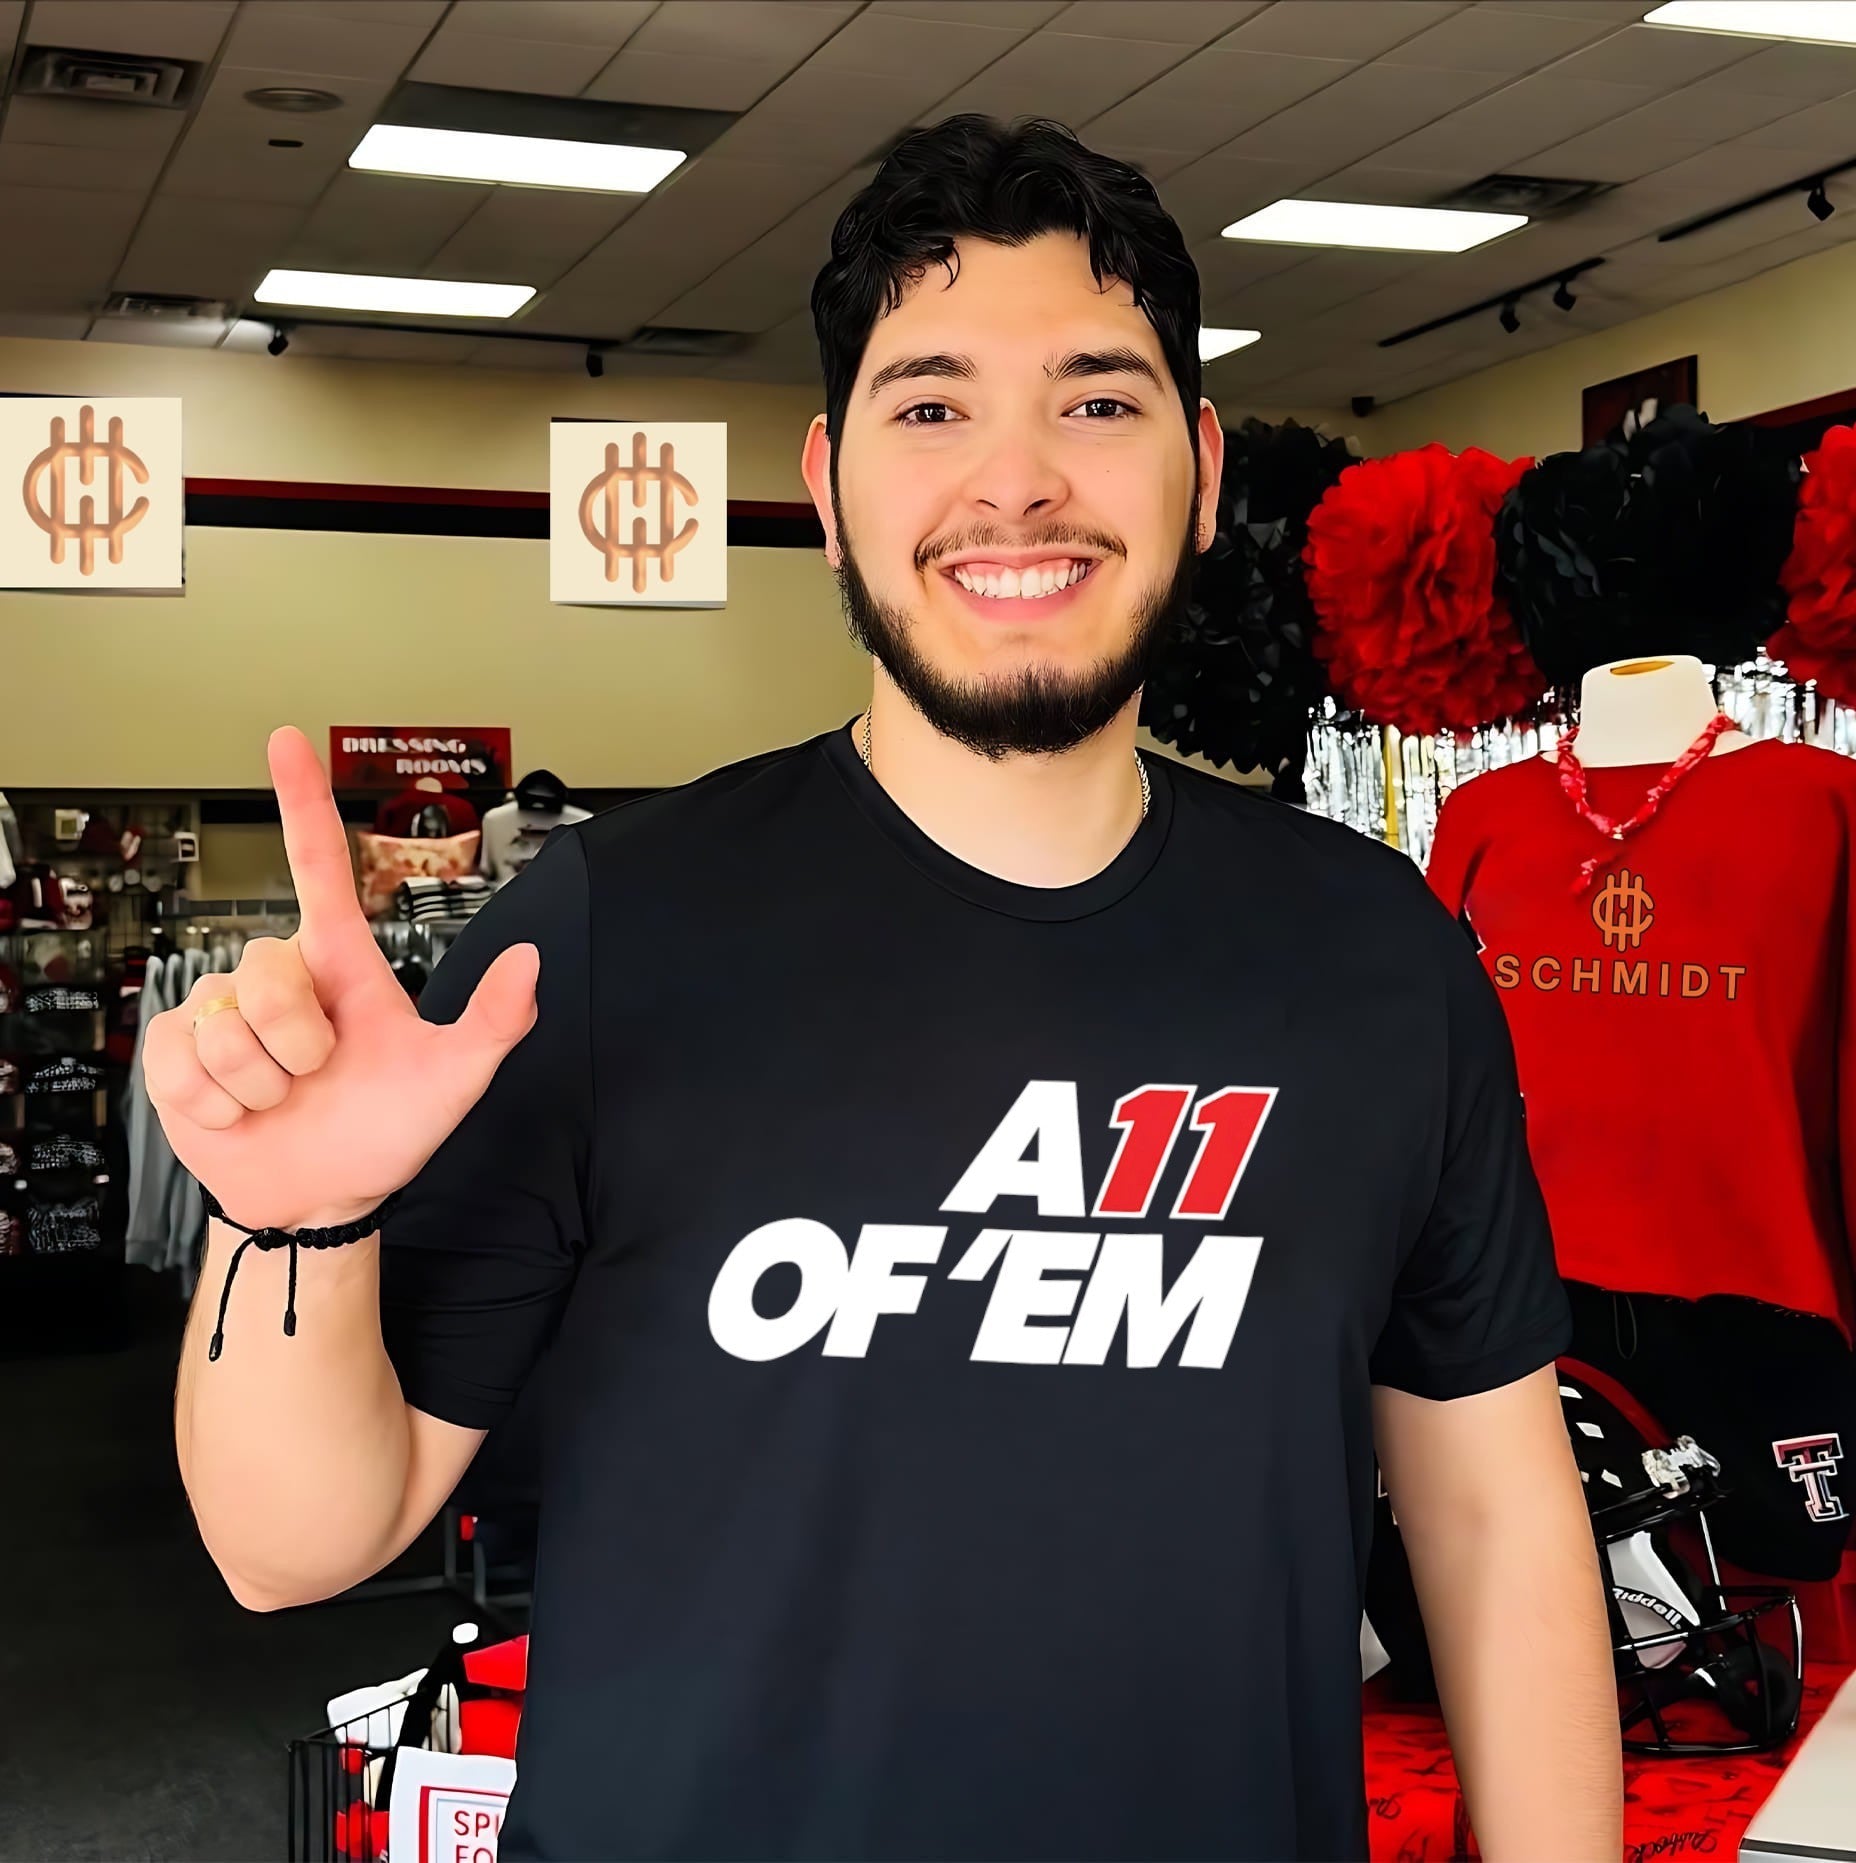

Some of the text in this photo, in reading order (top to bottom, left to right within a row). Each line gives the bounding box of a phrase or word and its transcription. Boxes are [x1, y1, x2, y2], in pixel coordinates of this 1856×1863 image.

[342, 737, 467, 754] DRESSING
[396, 758, 487, 775] ROOMS
[1494, 954, 1747, 1000] SCHMIDT
[938, 1080, 1280, 1220] A11
[707, 1217, 1264, 1369] OF 'EM
